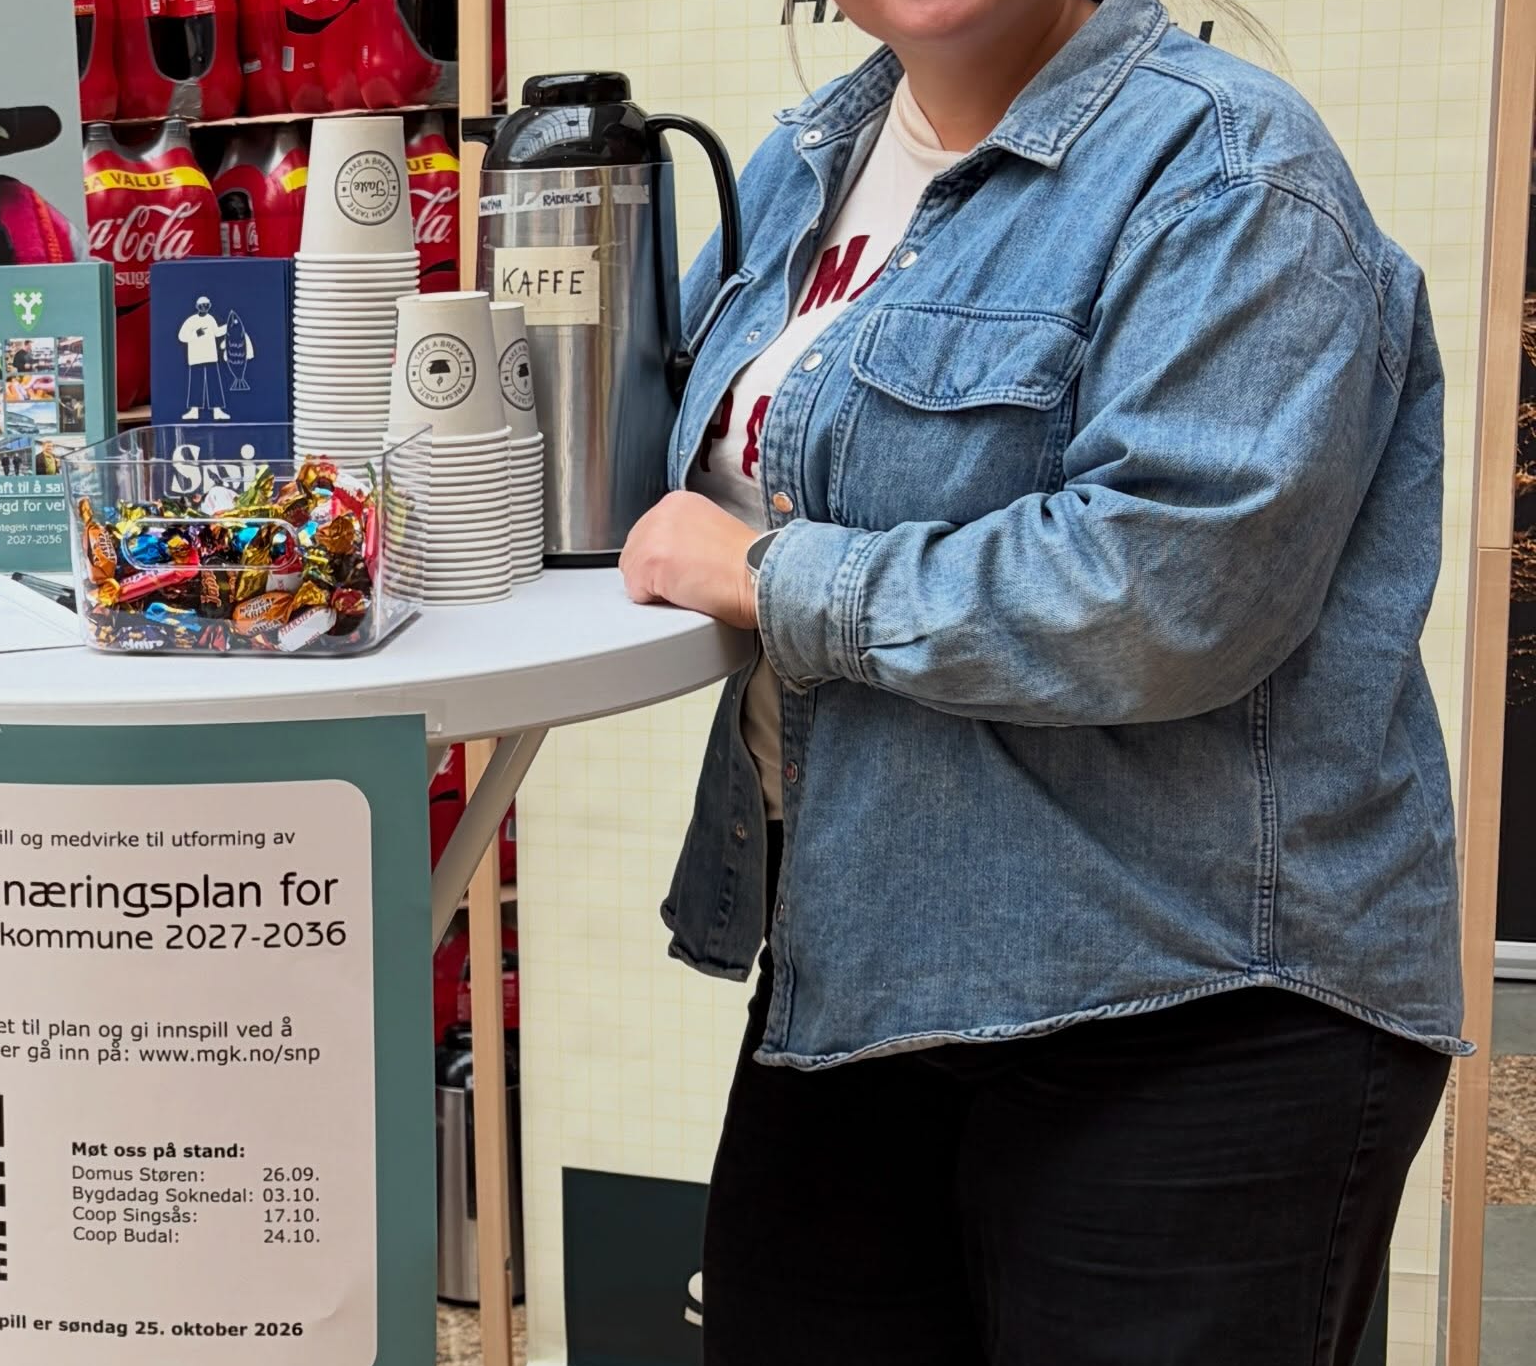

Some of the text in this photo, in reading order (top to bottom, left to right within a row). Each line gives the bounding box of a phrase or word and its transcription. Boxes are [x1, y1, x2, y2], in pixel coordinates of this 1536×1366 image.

[110, 172, 175, 187] VALUE
[88, 202, 202, 263] a-Cola
[115, 271, 151, 289] suga
[502, 267, 585, 297] KAFFE
[18, 482, 29, 494] til
[33, 480, 41, 493] å
[23, 500, 40, 511] for
[20, 832, 44, 849] og
[51, 830, 140, 848] medvirke
[146, 830, 164, 847] til
[171, 830, 266, 850] utforming
[273, 832, 296, 845] av
[3, 873, 262, 917] næringsplan
[280, 871, 339, 907] for
[0, 921, 153, 950] kommune
[165, 920, 346, 950] 2027-2036
[22, 1016, 41, 1036] til
[48, 1019, 90, 1042] plan
[99, 1024, 122, 1043] og
[131, 1020, 150, 1042] gi
[157, 1020, 228, 1039] innspill
[237, 1019, 273, 1039] ved
[280, 1016, 292, 1038] å
[28, 1040, 51, 1063] gå
[58, 1042, 89, 1061] inn
[98, 1037, 129, 1065] på:
[140, 1041, 320, 1065] www.mgk.no/snp
[72, 1142, 246, 1160] Møt oss på stand:
[72, 1166, 320, 1182] Domus Støren: 26.09.
[73, 1186, 320, 1205] Bygdadag Soknedal: 03.10.
[73, 1205, 320, 1225] Coop Singsås: 17.10.
[73, 1226, 320, 1245] Coop Budal: 24.10.
[33, 1317, 52, 1330] er
[59, 1320, 128, 1337] søndag
[135, 1321, 165, 1335] 25.
[171, 1321, 248, 1336] oktober
[254, 1323, 304, 1336] 2026
